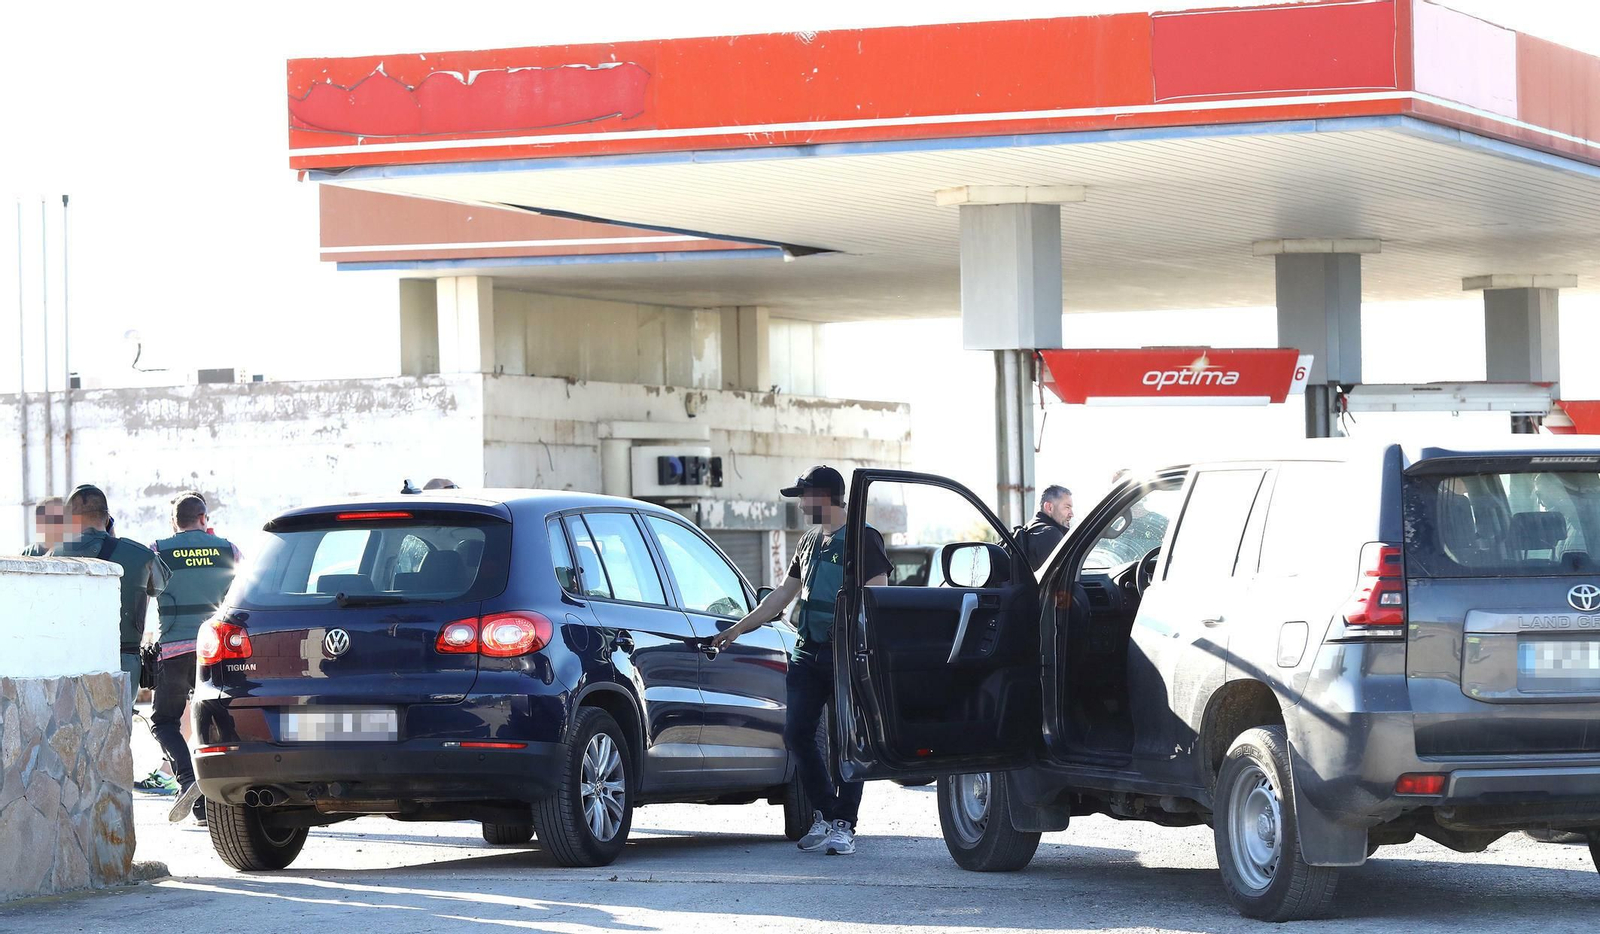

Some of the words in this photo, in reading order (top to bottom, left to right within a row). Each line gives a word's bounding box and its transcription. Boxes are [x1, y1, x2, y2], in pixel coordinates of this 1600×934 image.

[1142, 368, 1240, 391] optima
[1294, 366, 1307, 381] 6
[172, 548, 220, 558] GUARDIA
[185, 557, 214, 567] CIVIL
[1518, 615, 1571, 629] LAND
[226, 663, 257, 672] TIGUAN
